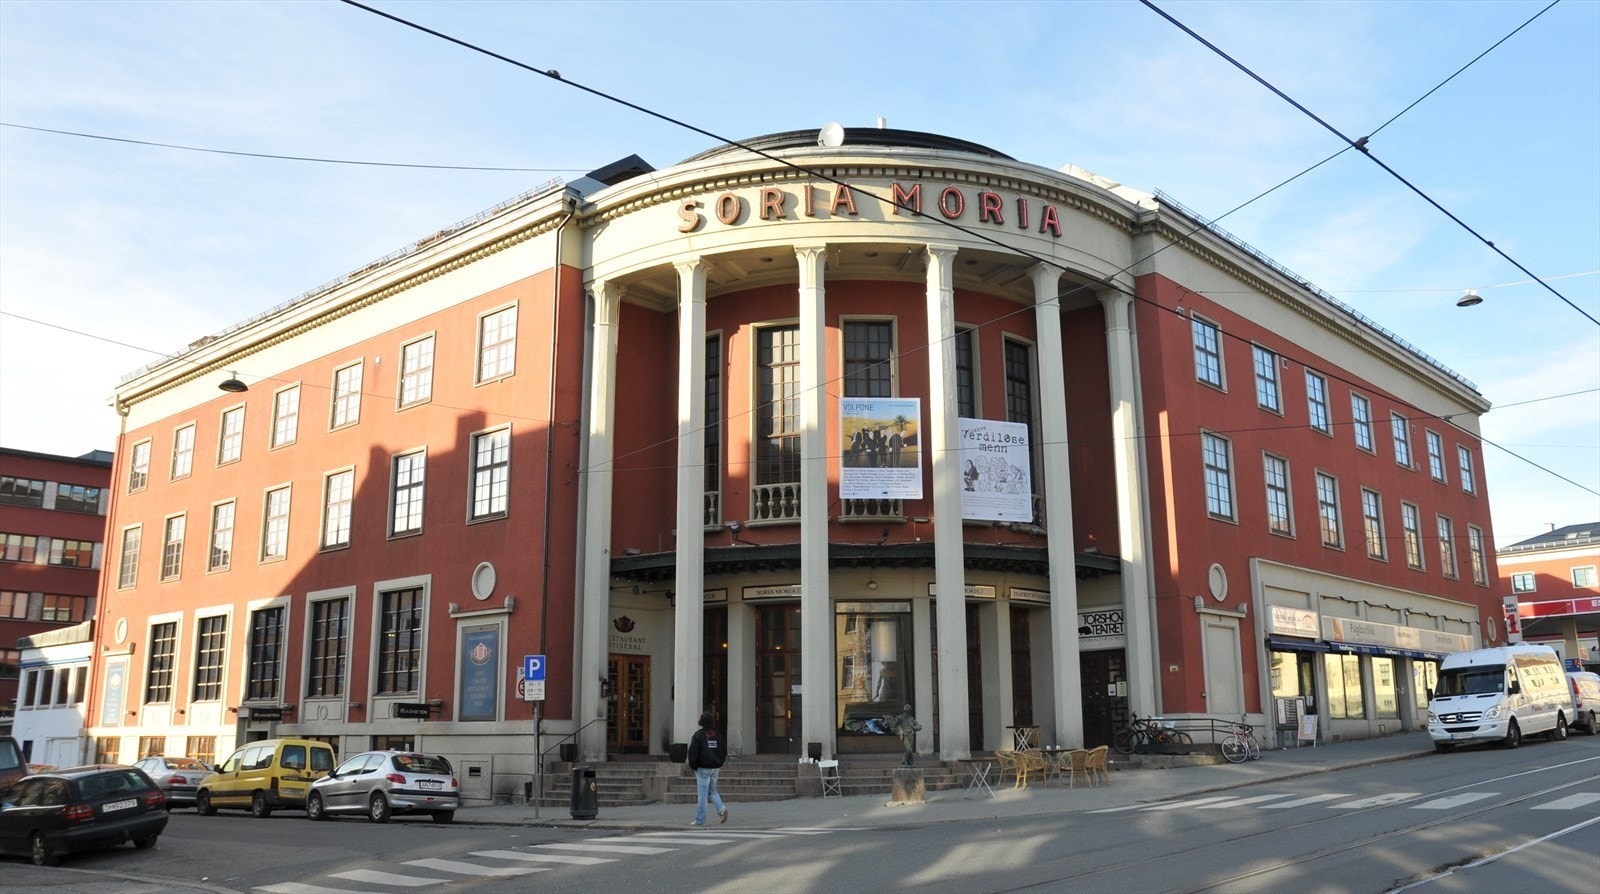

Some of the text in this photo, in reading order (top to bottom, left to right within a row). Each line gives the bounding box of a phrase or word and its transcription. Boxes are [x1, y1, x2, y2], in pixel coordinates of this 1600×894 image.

[678, 182, 1063, 237] SORIA MORIA
[843, 403, 875, 412] VOLPONE
[979, 443, 1008, 453] menn
[1090, 622, 1124, 635] TEATRET
[1349, 622, 1376, 637] Fagbutikk
[1506, 614, 1519, 634] 1
[608, 635, 646, 645] ESTAURANT
[529, 658, 541, 678] P
